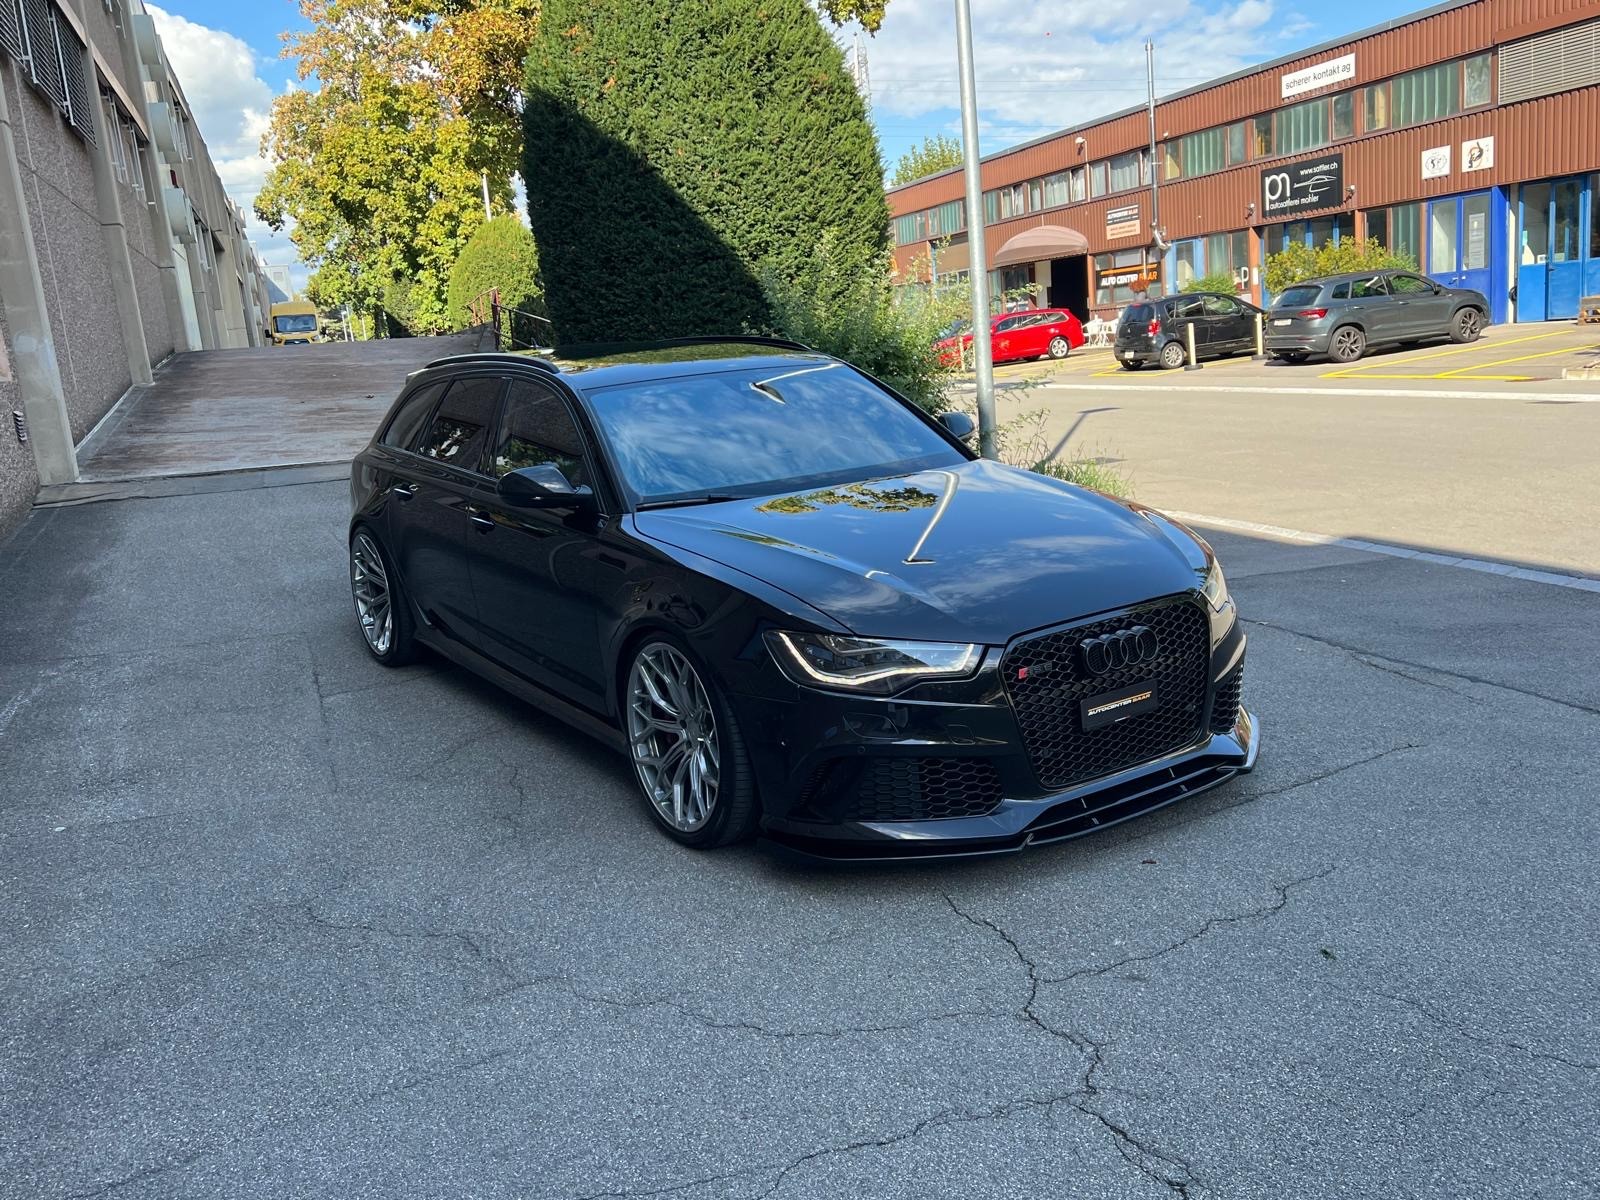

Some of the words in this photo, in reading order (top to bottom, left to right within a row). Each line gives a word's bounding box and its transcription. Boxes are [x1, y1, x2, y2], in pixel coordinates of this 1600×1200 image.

[1285, 75, 1311, 90] scherer
[1313, 64, 1340, 81] kontakt
[1341, 63, 1351, 73] ag
[1300, 161, 1338, 176] www.sattler.ch
[1300, 193, 1319, 204] mohler
[1101, 276, 1116, 287] AUTO
[1116, 273, 1138, 284] CENTER
[1088, 699, 1132, 716] AUTOCENTER
